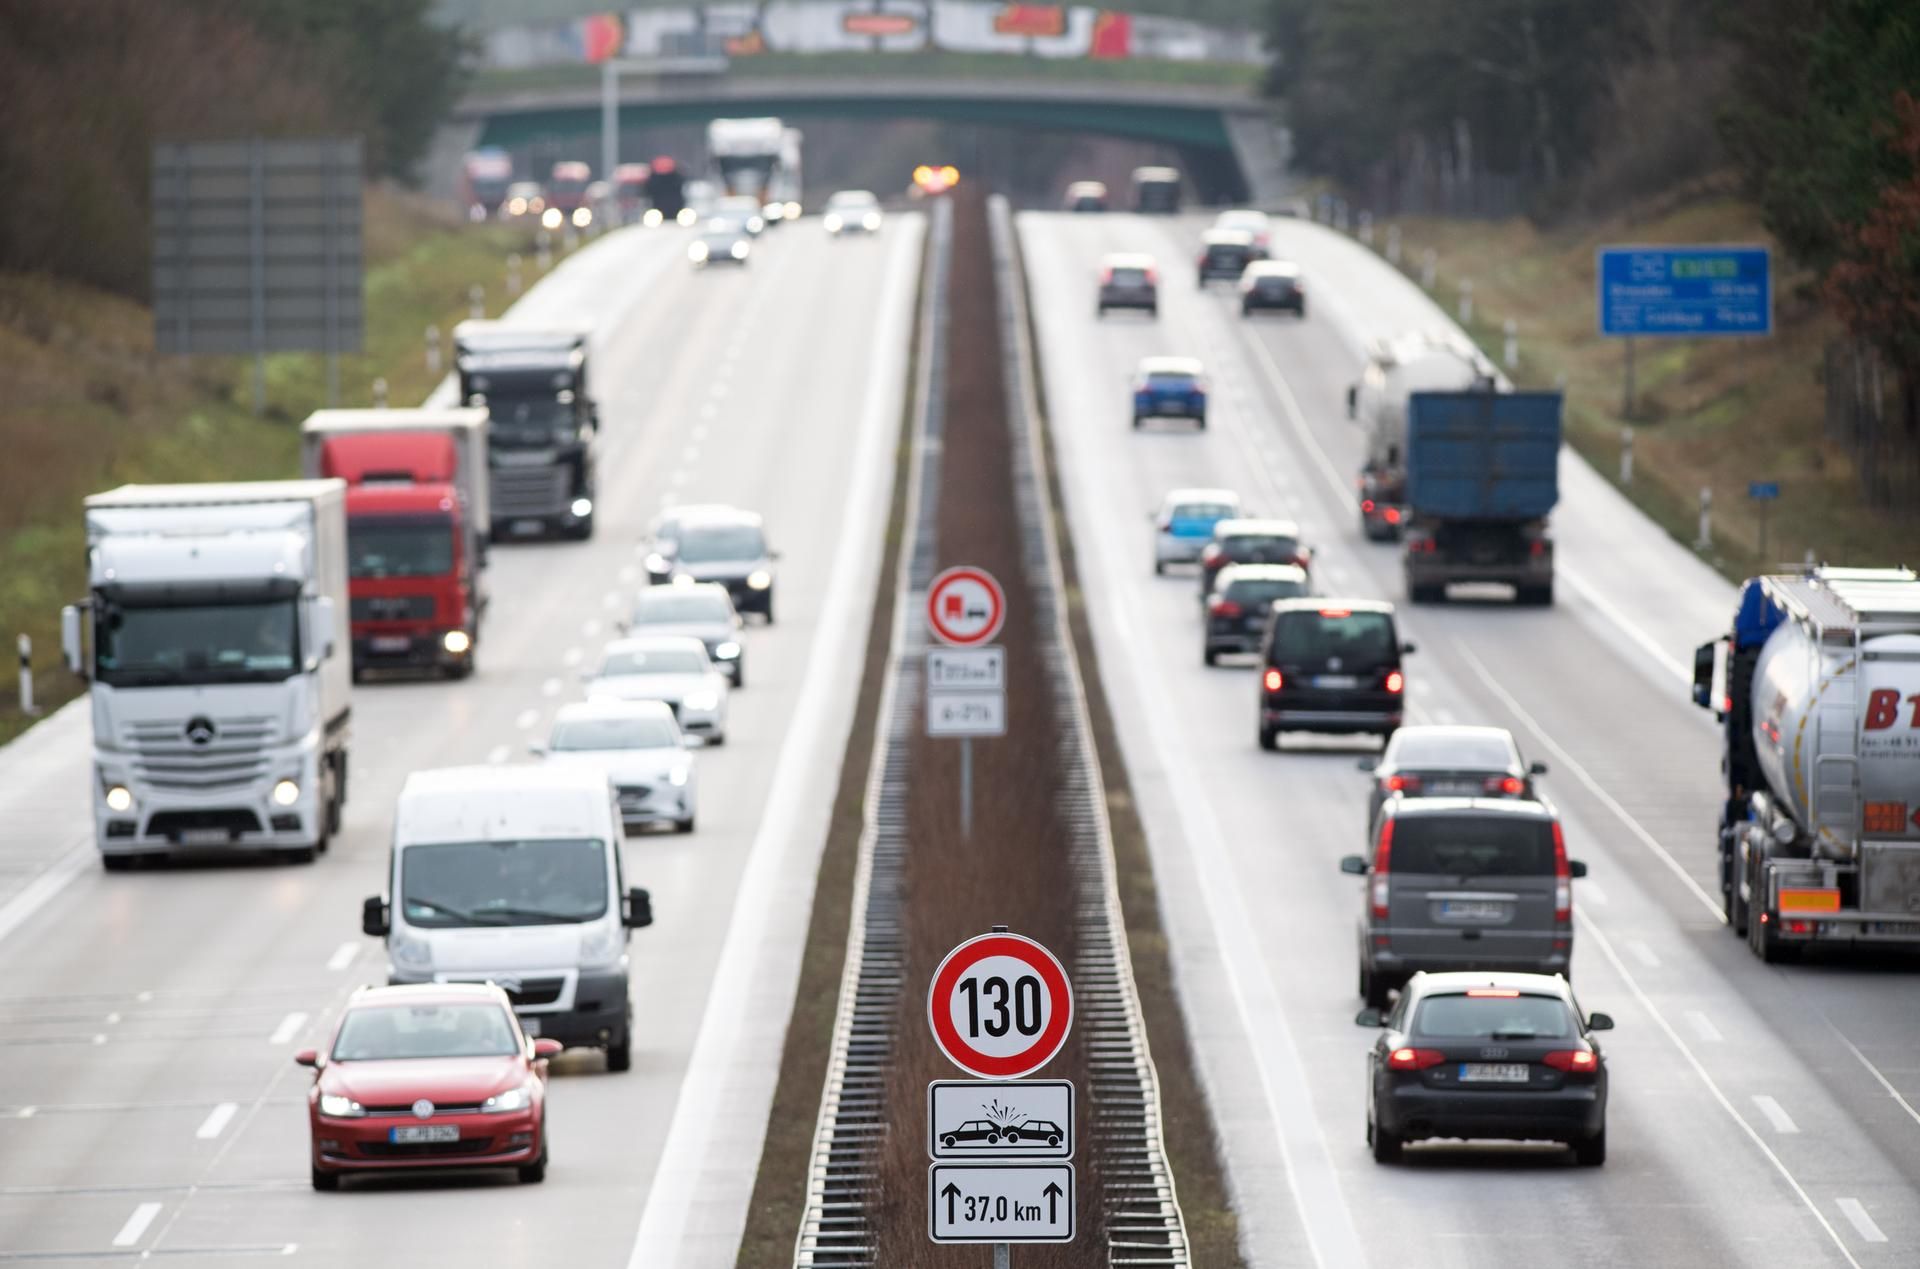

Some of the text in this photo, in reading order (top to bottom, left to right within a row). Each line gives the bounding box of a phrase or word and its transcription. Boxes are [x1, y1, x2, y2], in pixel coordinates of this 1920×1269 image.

[959, 975, 1042, 1038] 130
[964, 1195, 1041, 1223] 37,0 km
